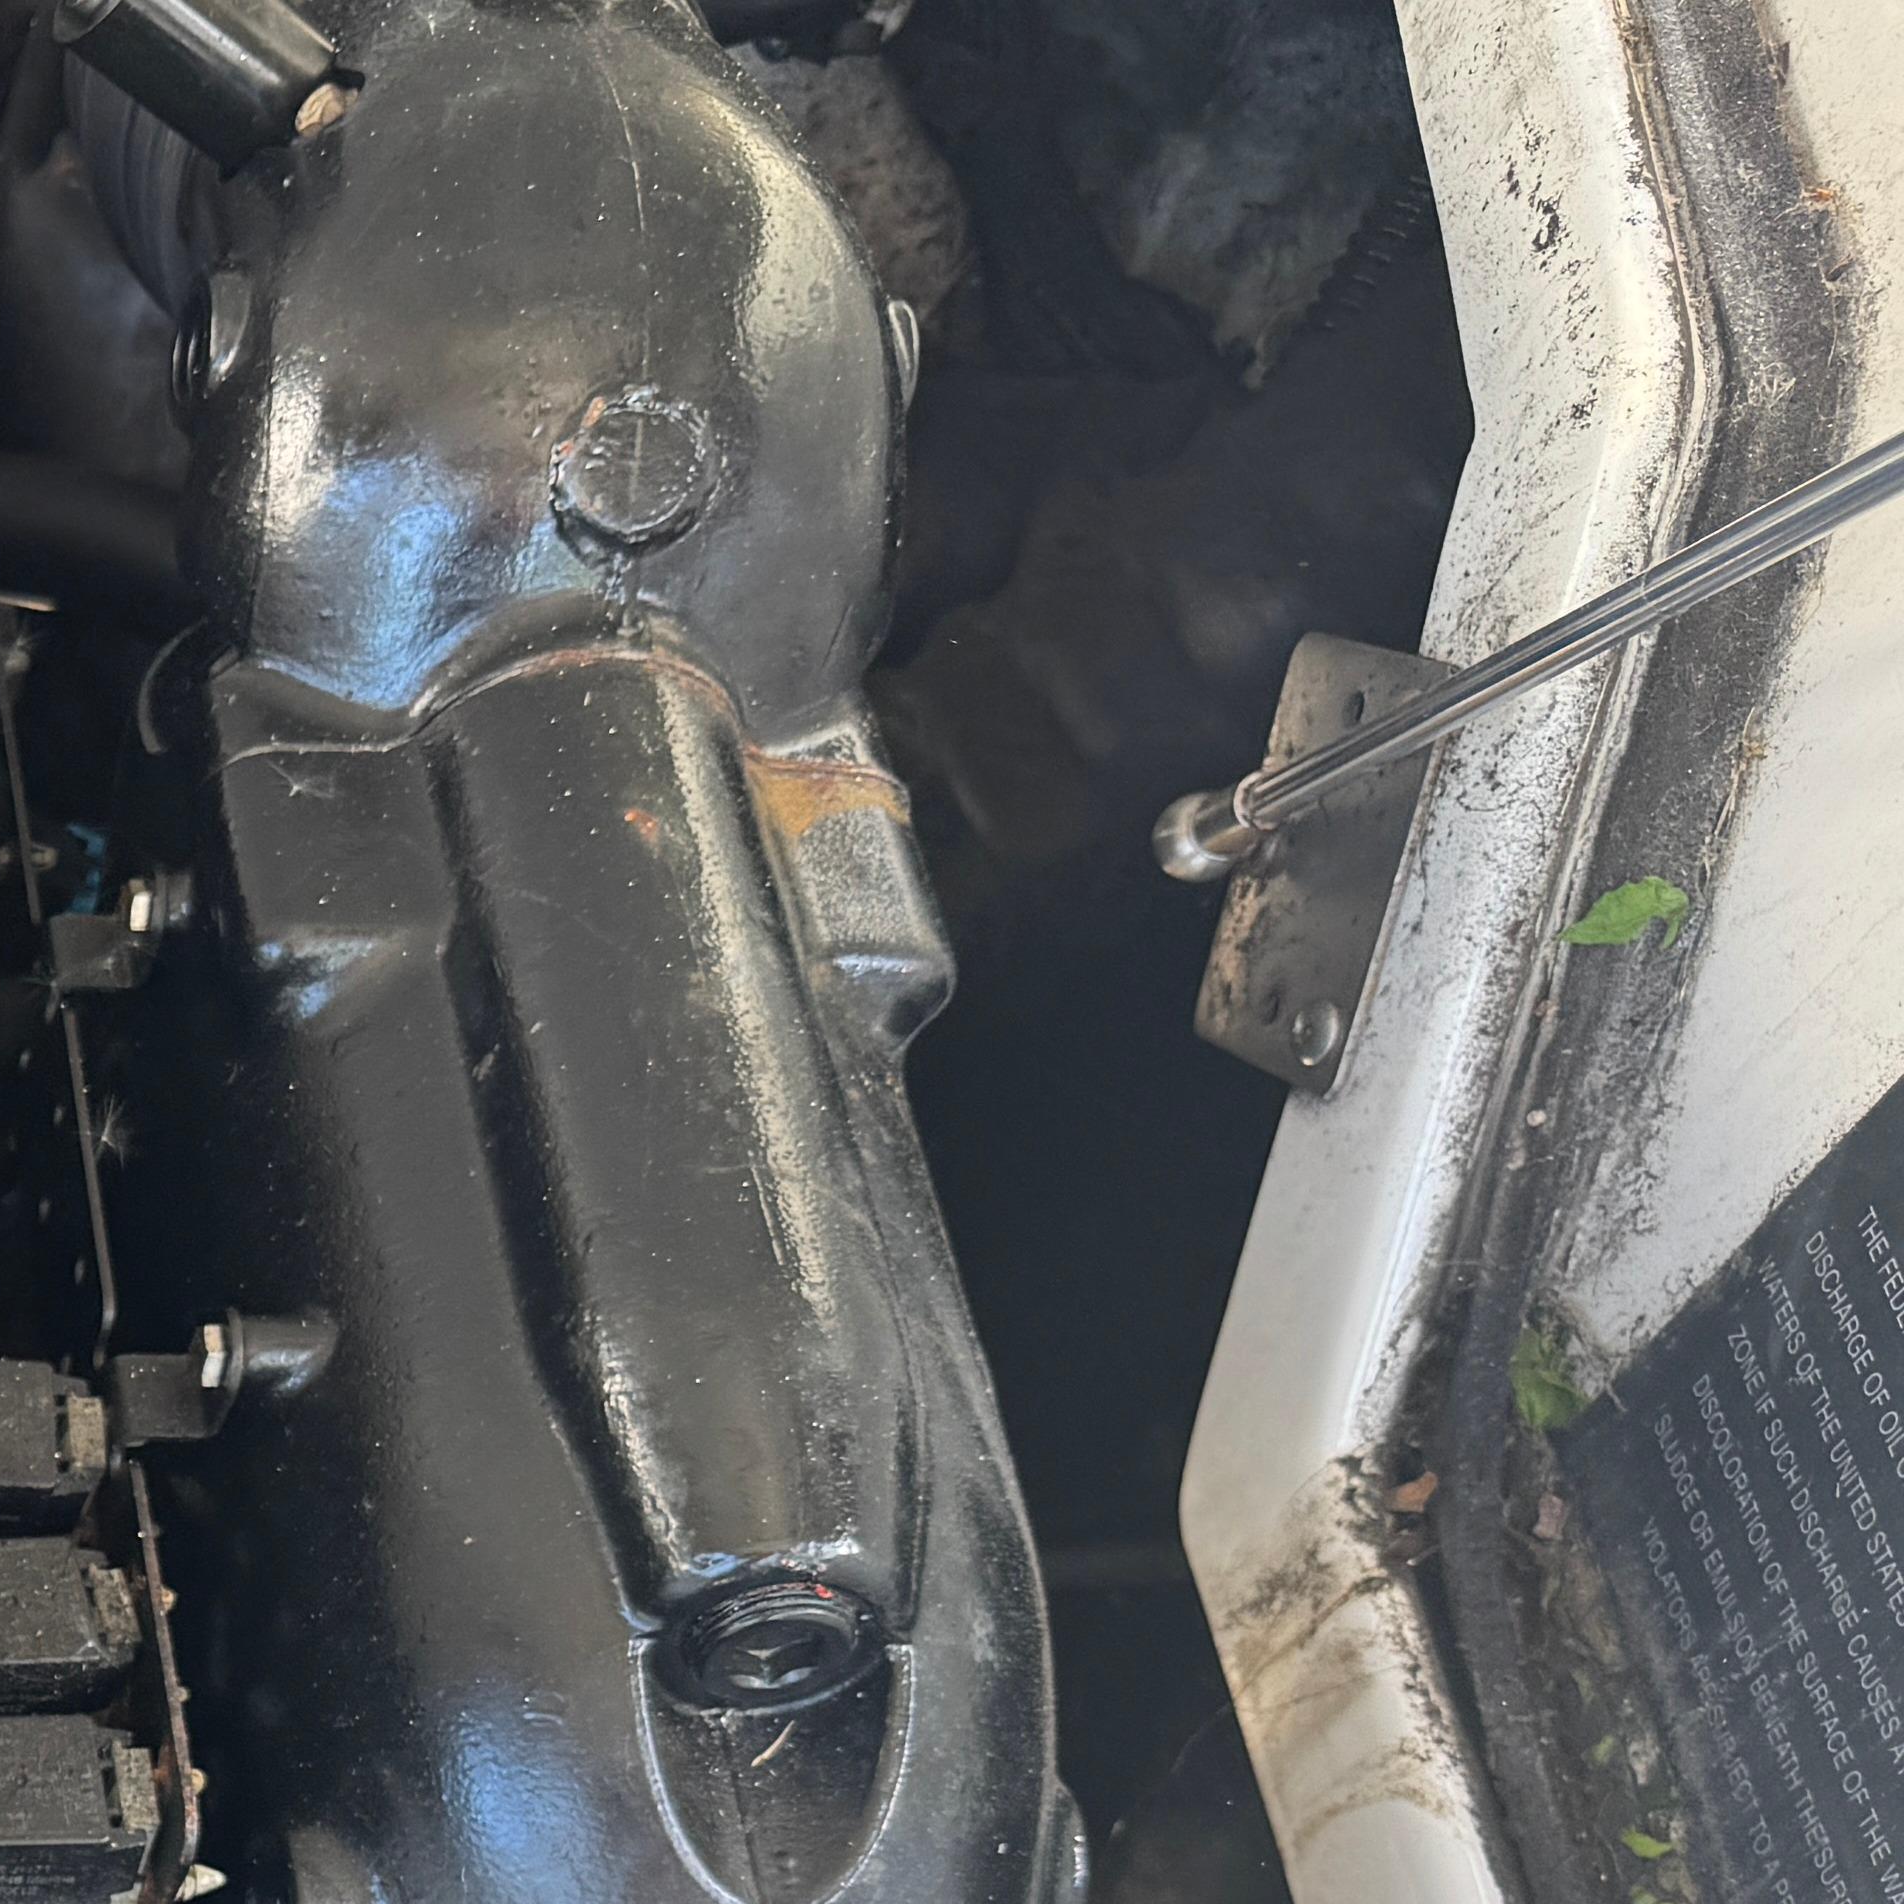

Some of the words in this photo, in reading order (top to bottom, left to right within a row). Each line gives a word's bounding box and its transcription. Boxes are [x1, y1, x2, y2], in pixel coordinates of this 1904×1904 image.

[1858, 1205, 1890, 1263] THE
[1727, 1323, 1767, 1396] ZONE
[1805, 1230, 1874, 1374] DISCHARGE
[1863, 1372, 1890, 1406] OF
[1754, 1391, 1776, 1416] IF
[1758, 1254, 1806, 1354] WATERS
[1795, 1353, 1822, 1386] OF
[1811, 1386, 1843, 1443] THE
[1830, 1437, 1876, 1531] UNITED
[1763, 1418, 1803, 1491] SUCH
[1654, 1413, 1701, 1512] SLUDGE
[1689, 1510, 1715, 1551] OR
[1703, 1549, 1761, 1677] EMULSION
[1750, 1673, 1805, 1791] BENEATH
[1796, 1787, 1829, 1849] THE
[1692, 1373, 1774, 1563] DISCOLORATION
[1763, 1561, 1789, 1595] OF
[1778, 1597, 1809, 1654] THE
[1796, 1651, 1855, 1771] SURFACE
[1842, 1769, 1871, 1805] OF
[1858, 1807, 1892, 1867] THE
[1790, 1487, 1860, 1635] DISCHARGE
[1642, 1515, 1697, 1652] VIOLATORS
[1748, 1814, 1772, 1855] TO
[1847, 1634, 1901, 1740] CAUSES
